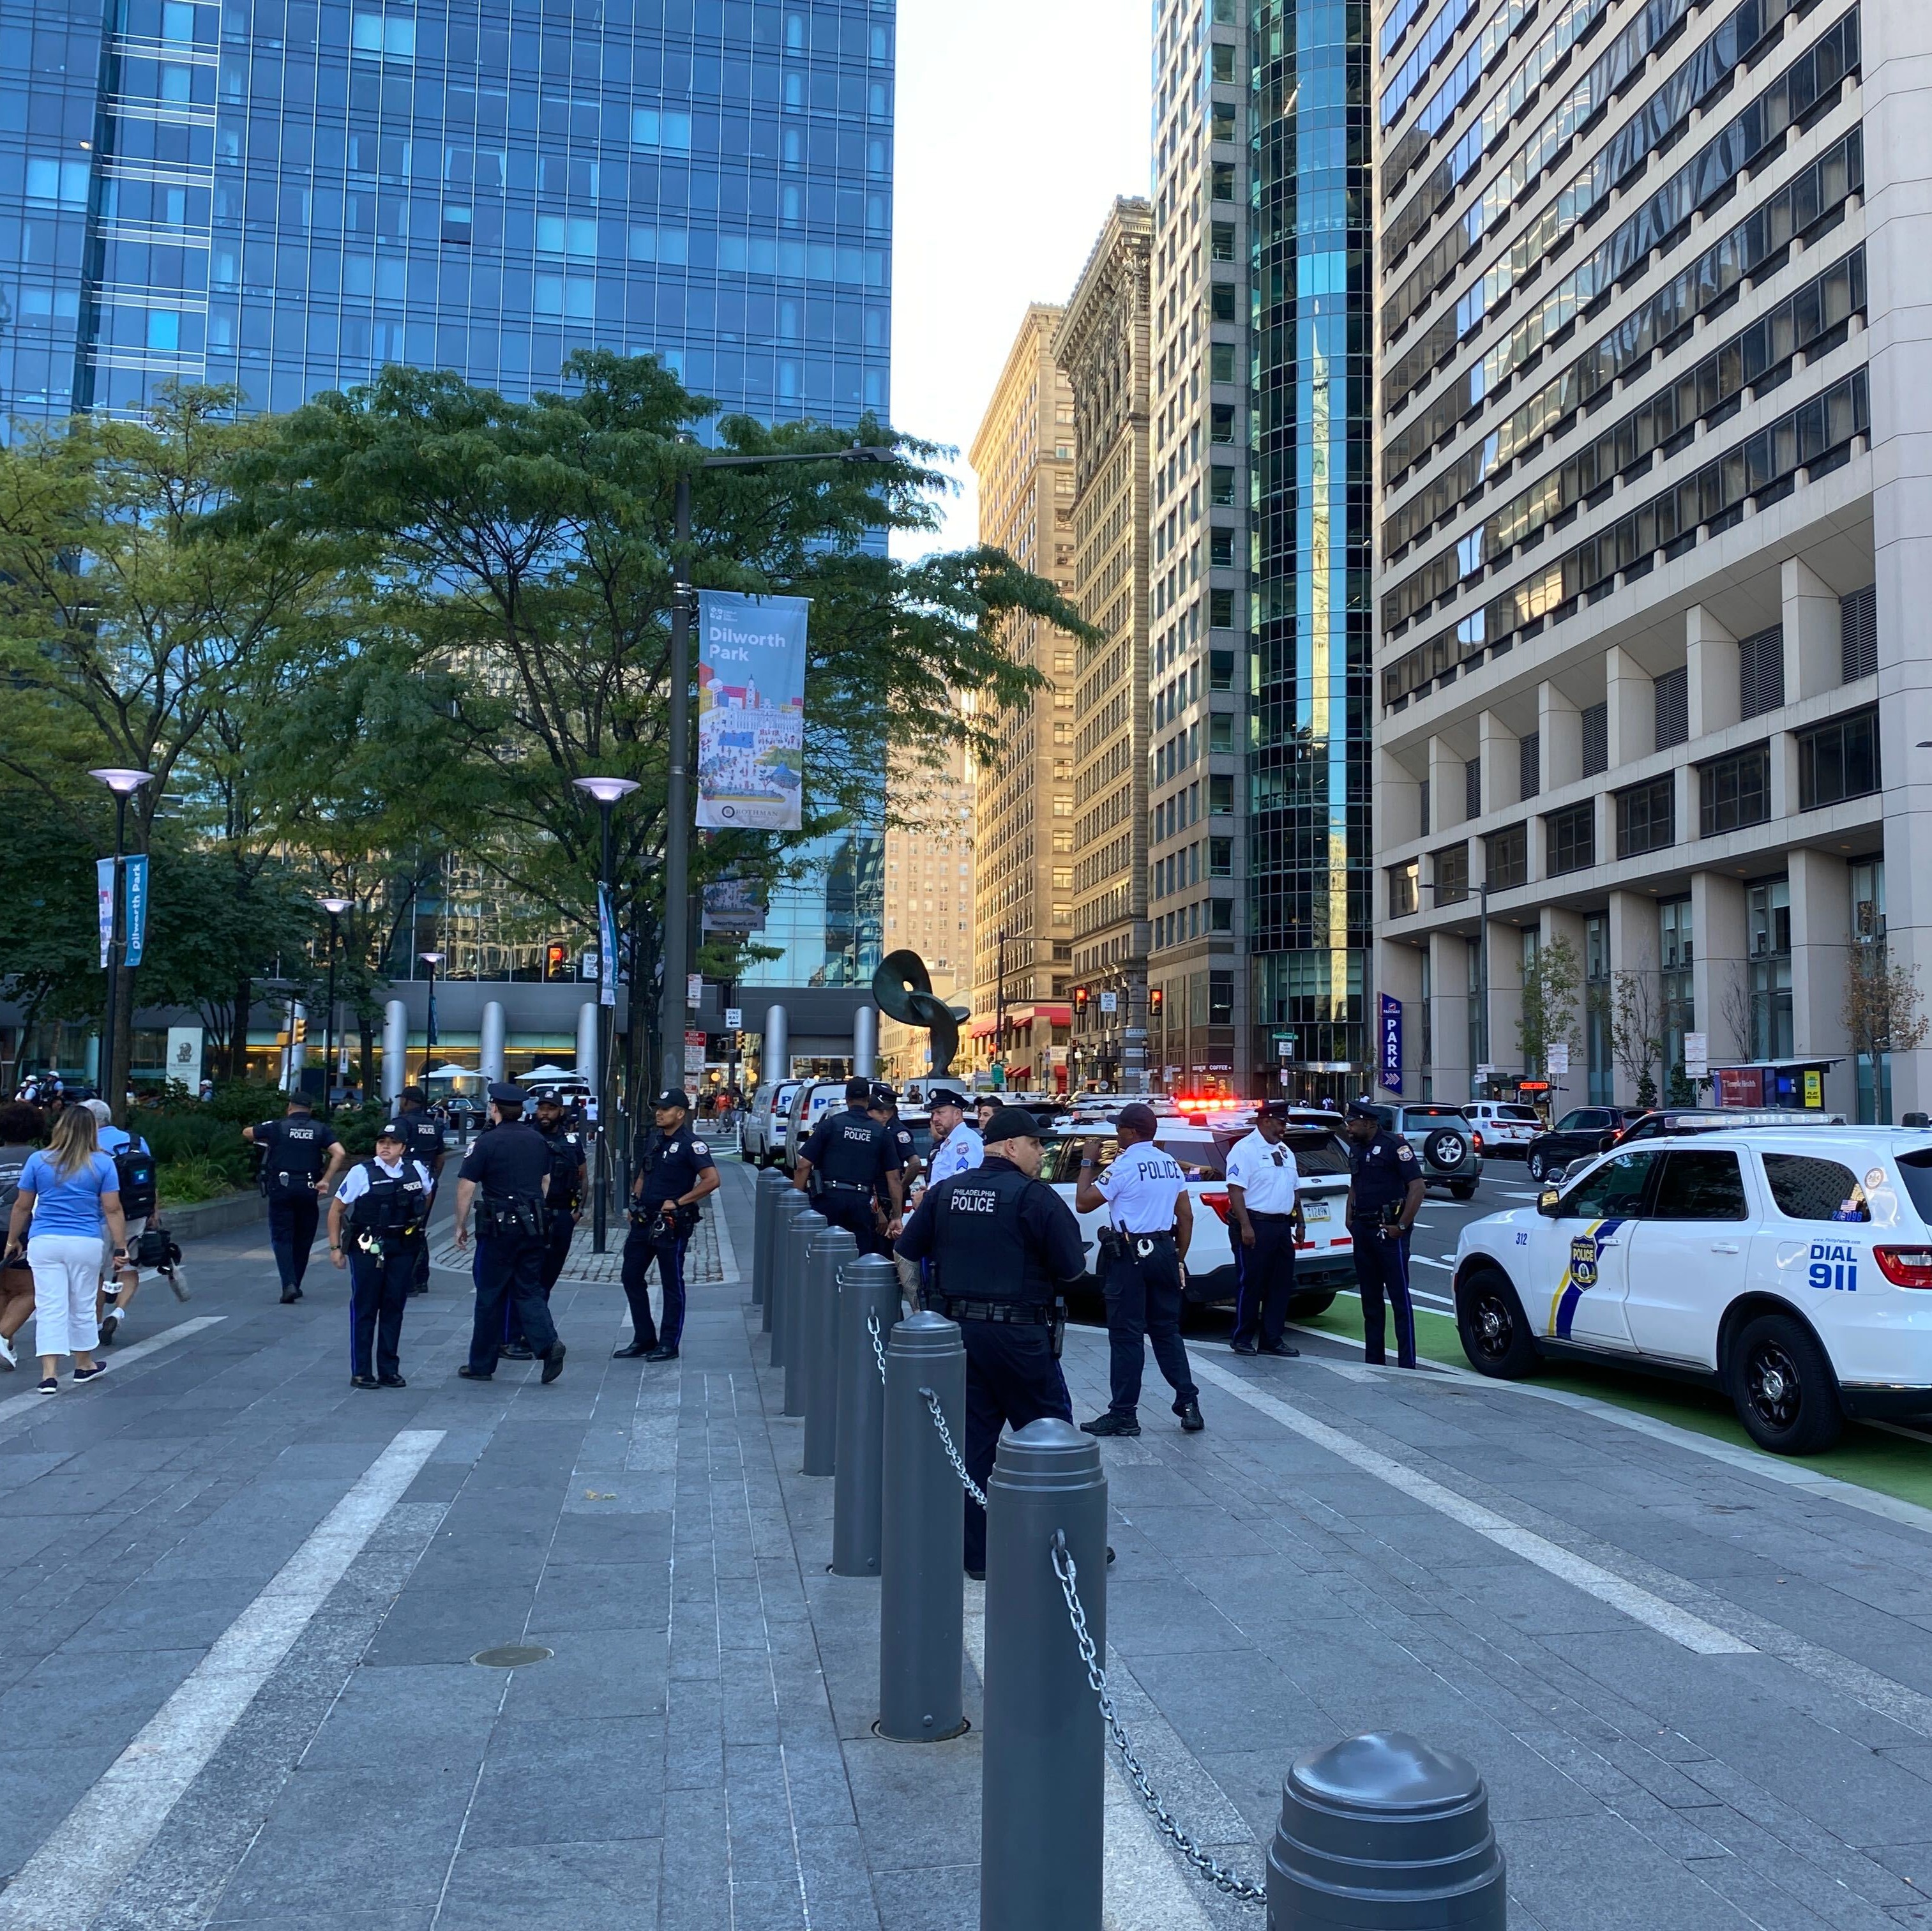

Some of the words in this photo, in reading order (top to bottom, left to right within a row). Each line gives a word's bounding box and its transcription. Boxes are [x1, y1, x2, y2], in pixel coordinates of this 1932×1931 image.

[709, 626, 785, 647] Dilworth
[709, 644, 749, 662] Park
[735, 808, 778, 817] ROTHMAN
[132, 863, 141, 892] Park
[132, 895, 141, 950] Dilworth
[1387, 1019, 1398, 1068] PARK
[1726, 1080, 1741, 1089] Temple
[289, 1131, 313, 1140] POLICE
[843, 1130, 872, 1142] POLICE
[1136, 1160, 1180, 1181] POLICE
[953, 1188, 995, 1197] PHILADELPHIA
[951, 1195, 995, 1213] POLICE
[1516, 1232, 1528, 1245] 312
[1573, 1248, 1594, 1262] POLICE
[1810, 1245, 1857, 1262] DIAL
[1809, 1263, 1857, 1291] 911
